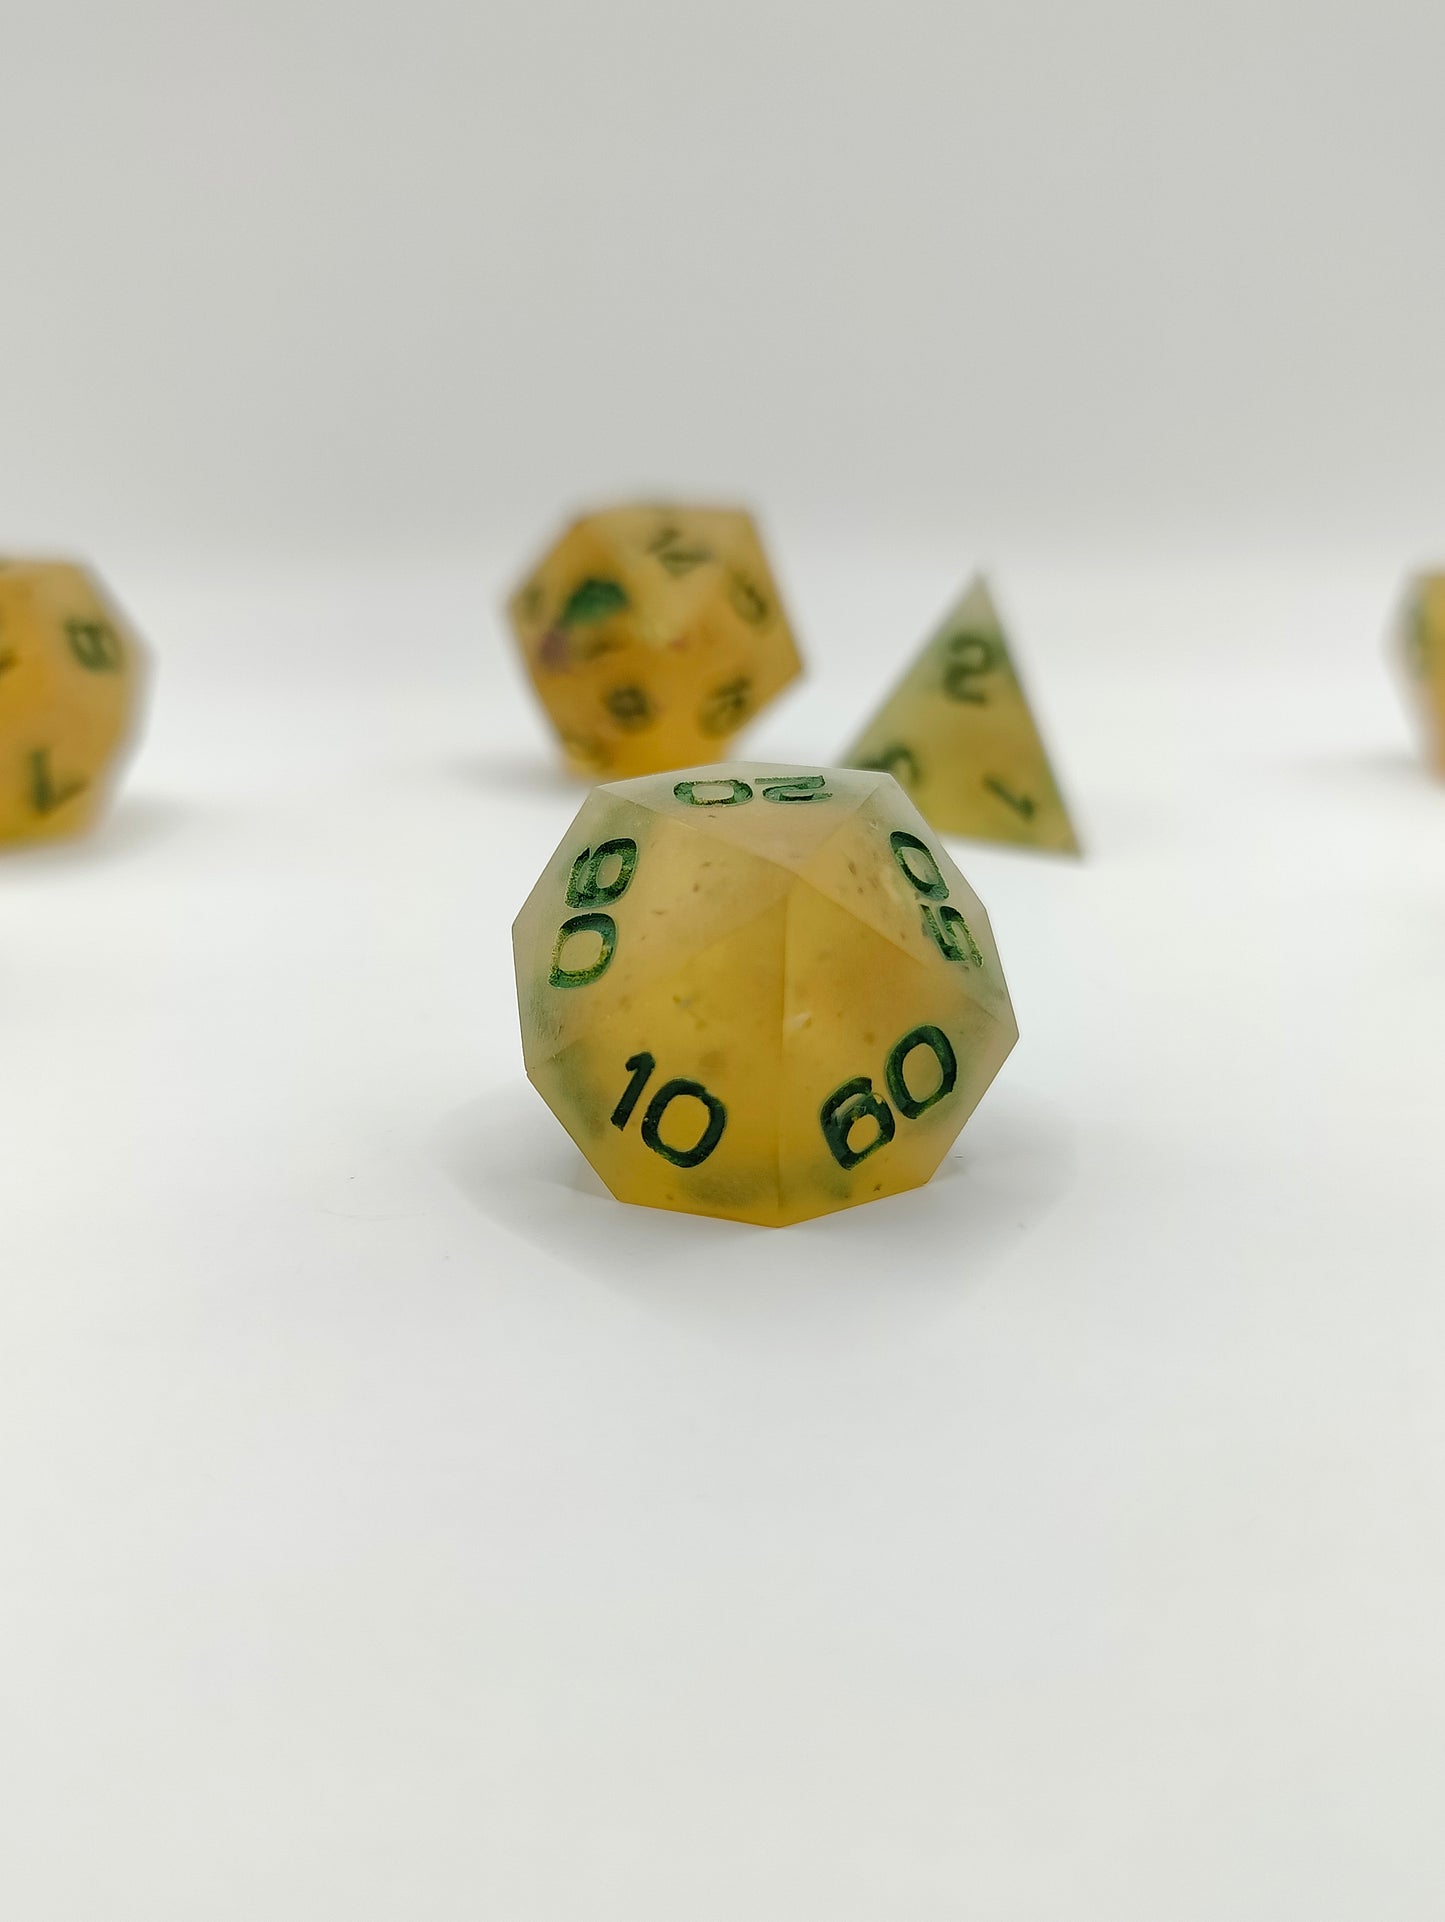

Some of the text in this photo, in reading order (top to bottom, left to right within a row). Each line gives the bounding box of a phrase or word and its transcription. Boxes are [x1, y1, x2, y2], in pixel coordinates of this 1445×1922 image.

[944, 632, 996, 706] 2
[673, 775, 833, 807] 20
[548, 837, 638, 989] 90
[889, 830, 984, 968] 50
[610, 1050, 727, 1168] 10
[820, 1023, 957, 1170] 60
